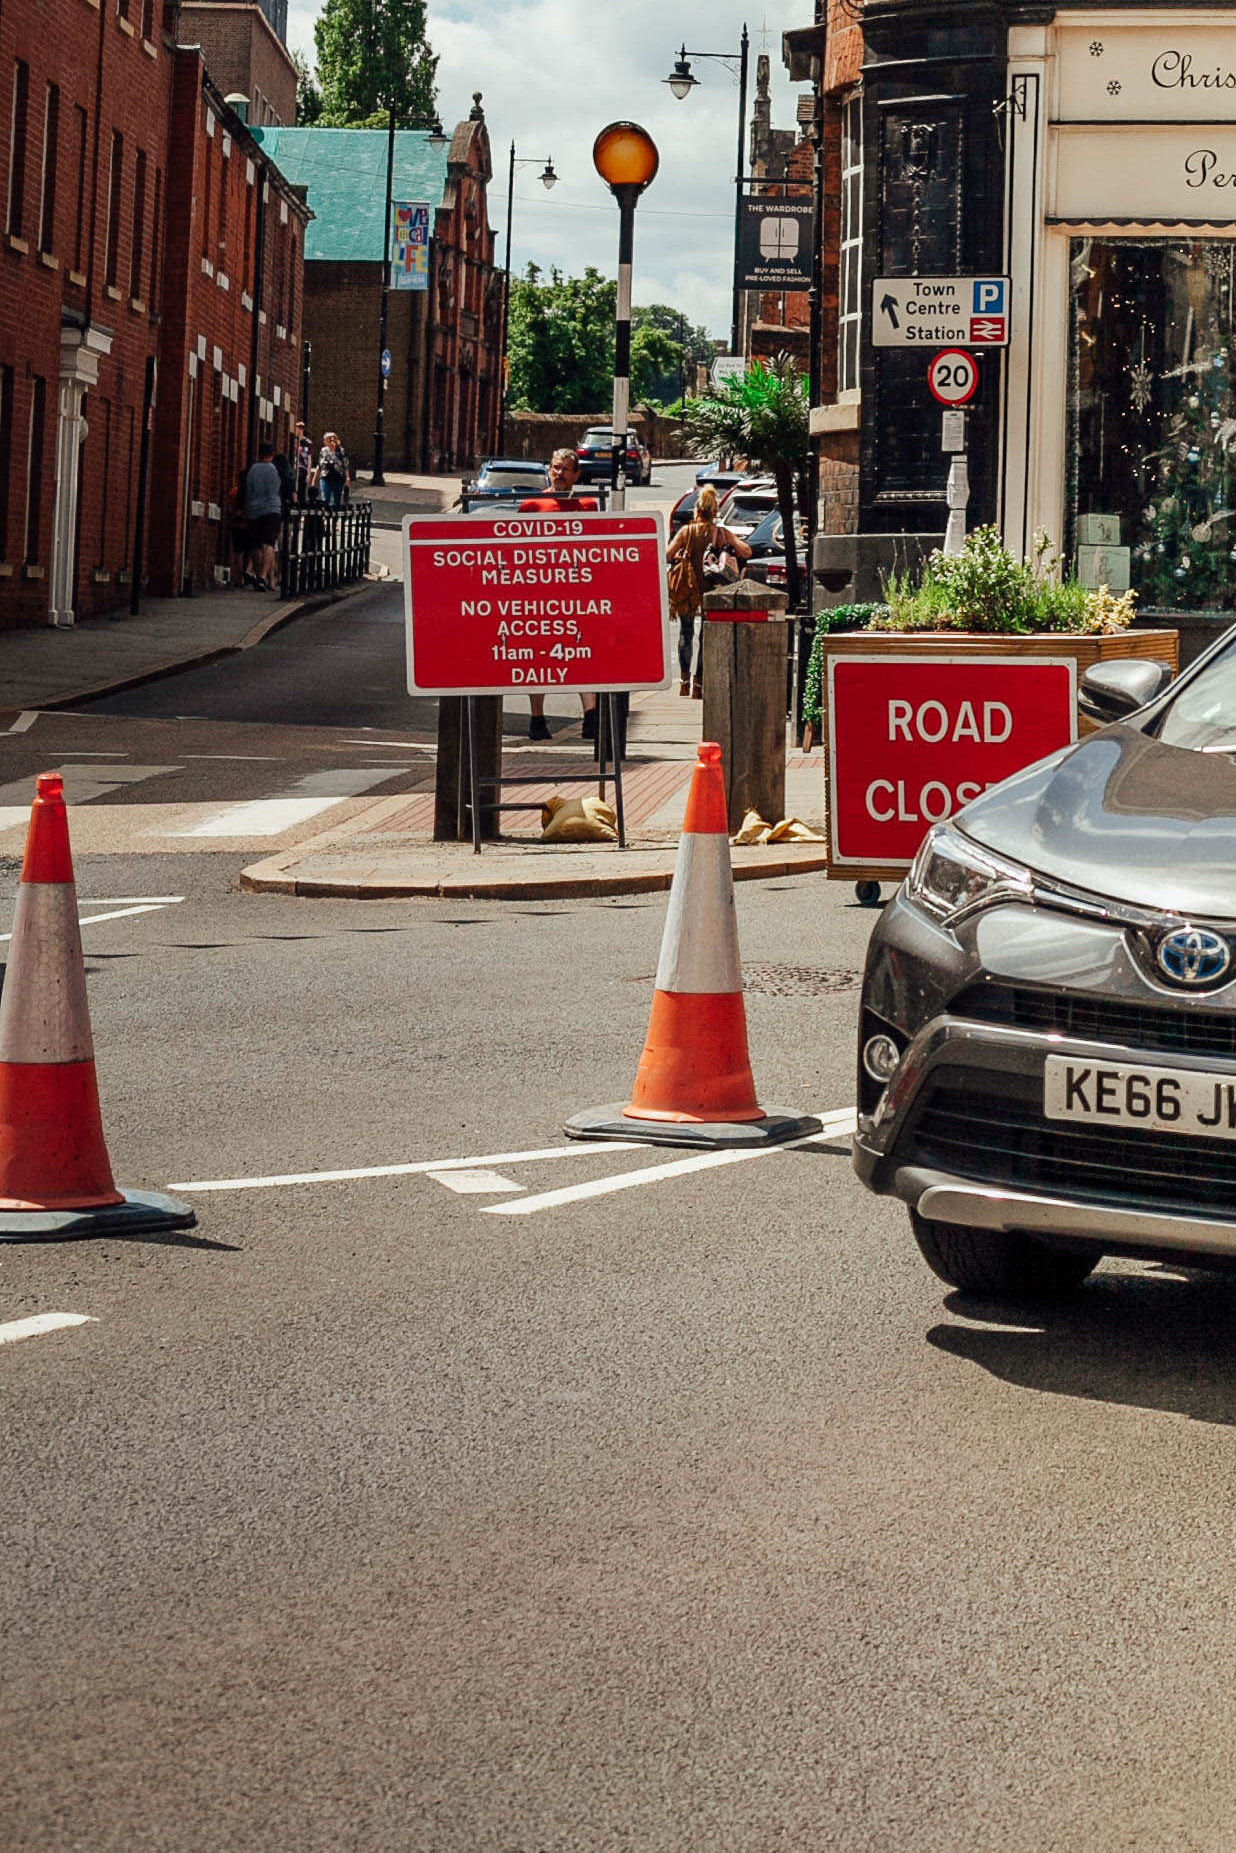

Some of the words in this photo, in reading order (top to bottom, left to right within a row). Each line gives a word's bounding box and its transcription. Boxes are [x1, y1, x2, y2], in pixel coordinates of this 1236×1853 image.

[747, 204, 764, 212] THE
[765, 206, 814, 214] WARDROBE
[782, 275, 811, 283] FASHION
[913, 282, 956, 296] Town
[979, 284, 999, 311] P
[905, 301, 961, 315] Centre
[905, 325, 966, 341] Station
[936, 365, 969, 388] 20
[493, 521, 584, 538] COVID-19
[433, 550, 507, 567] SOCIAL
[513, 547, 640, 565] DISTANCING
[482, 567, 593, 585] MEASURES
[461, 601, 492, 617] NO
[498, 599, 612, 616] VEHICULAR
[497, 619, 578, 636] ACCESS
[492, 645, 534, 661] 11am
[550, 643, 592, 662] 4pm
[511, 668, 568, 684] DAILY
[888, 700, 1013, 743] ROAD
[865, 779, 1000, 823] CLOS
[1065, 1067, 1181, 1122] KE66
